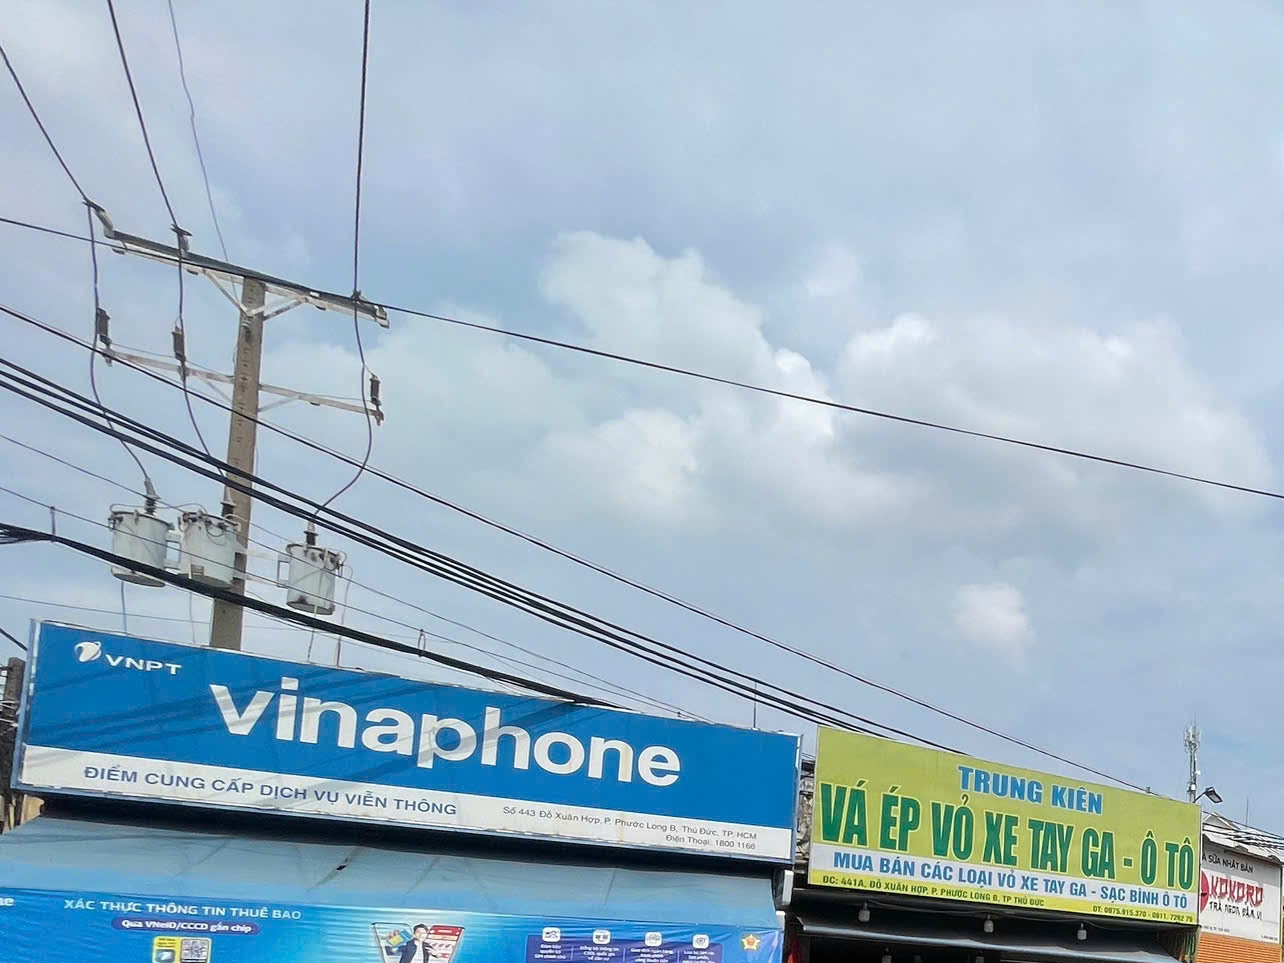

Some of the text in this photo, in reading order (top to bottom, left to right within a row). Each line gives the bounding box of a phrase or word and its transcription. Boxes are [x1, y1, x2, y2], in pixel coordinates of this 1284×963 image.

[105, 654, 182, 675] VNPT
[209, 677, 680, 787] vinaphone
[84, 764, 457, 816] ĐIỂM CUNG CẤP DỊCH VỤ VIỄN THÔNG
[958, 765, 1103, 815] TRUNG KIÊN
[518, 808, 536, 817] 443
[555, 812, 579, 822] Xuân
[646, 821, 668, 833] Long
[736, 831, 757, 840] HCM
[820, 779, 1195, 892] VÁ ÉP VỎ XE TAY GA - Ô TÔ
[715, 839, 735, 848] 1800
[834, 851, 873, 872] MUA
[879, 849, 915, 877] BÁN
[920, 855, 954, 882] CÁC
[958, 866, 993, 889] LOẠI
[997, 869, 1016, 889] VỎ
[1020, 874, 1039, 892] XE
[1043, 877, 1066, 894] TAY
[1069, 881, 1087, 897] GA
[1100, 886, 1126, 904] SẠC
[1129, 885, 1159, 905] BÌNH
[1163, 891, 1170, 907] Ô
[1174, 893, 1188, 909] TÔ
[1210, 875, 1264, 908] KOKORO
[63, 897, 95, 911] XÁC
[146, 900, 198, 917] THÔNG
[202, 906, 226, 917] TIN
[230, 904, 269, 919] THUÊ
[272, 909, 302, 920] BAO
[970, 890, 991, 901] LONG
[121, 919, 143, 930] Qua
[230, 923, 252, 934] chip
